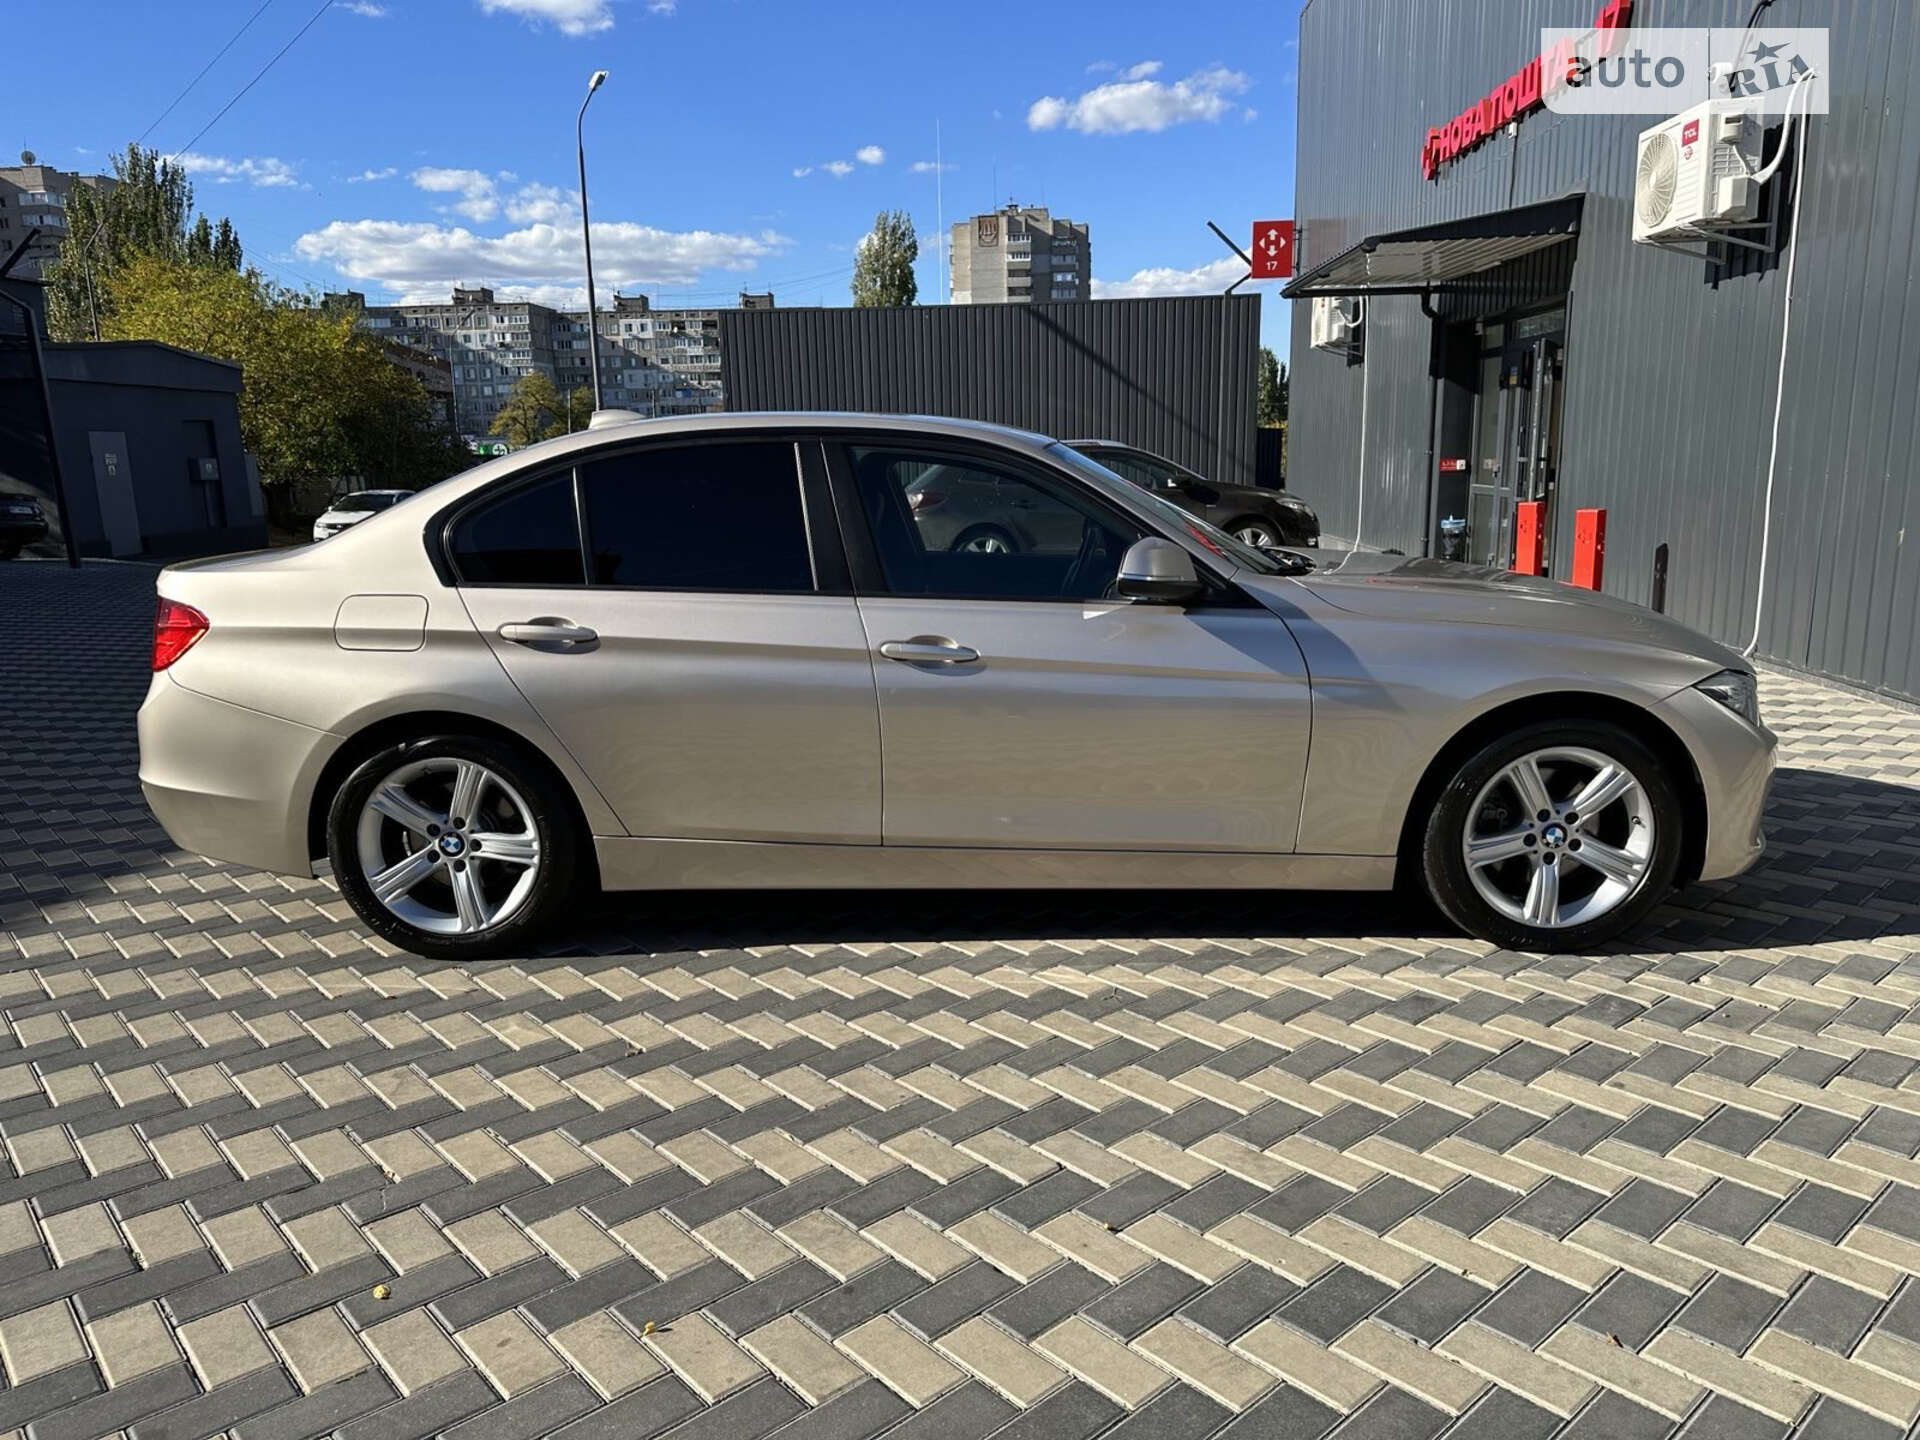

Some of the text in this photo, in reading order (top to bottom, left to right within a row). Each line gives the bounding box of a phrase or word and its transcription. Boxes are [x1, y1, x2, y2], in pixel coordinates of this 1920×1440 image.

[1439, 98, 1490, 162] НОВА
[1489, 37, 1572, 128] ПОШТА
[1265, 260, 1279, 271] 17
